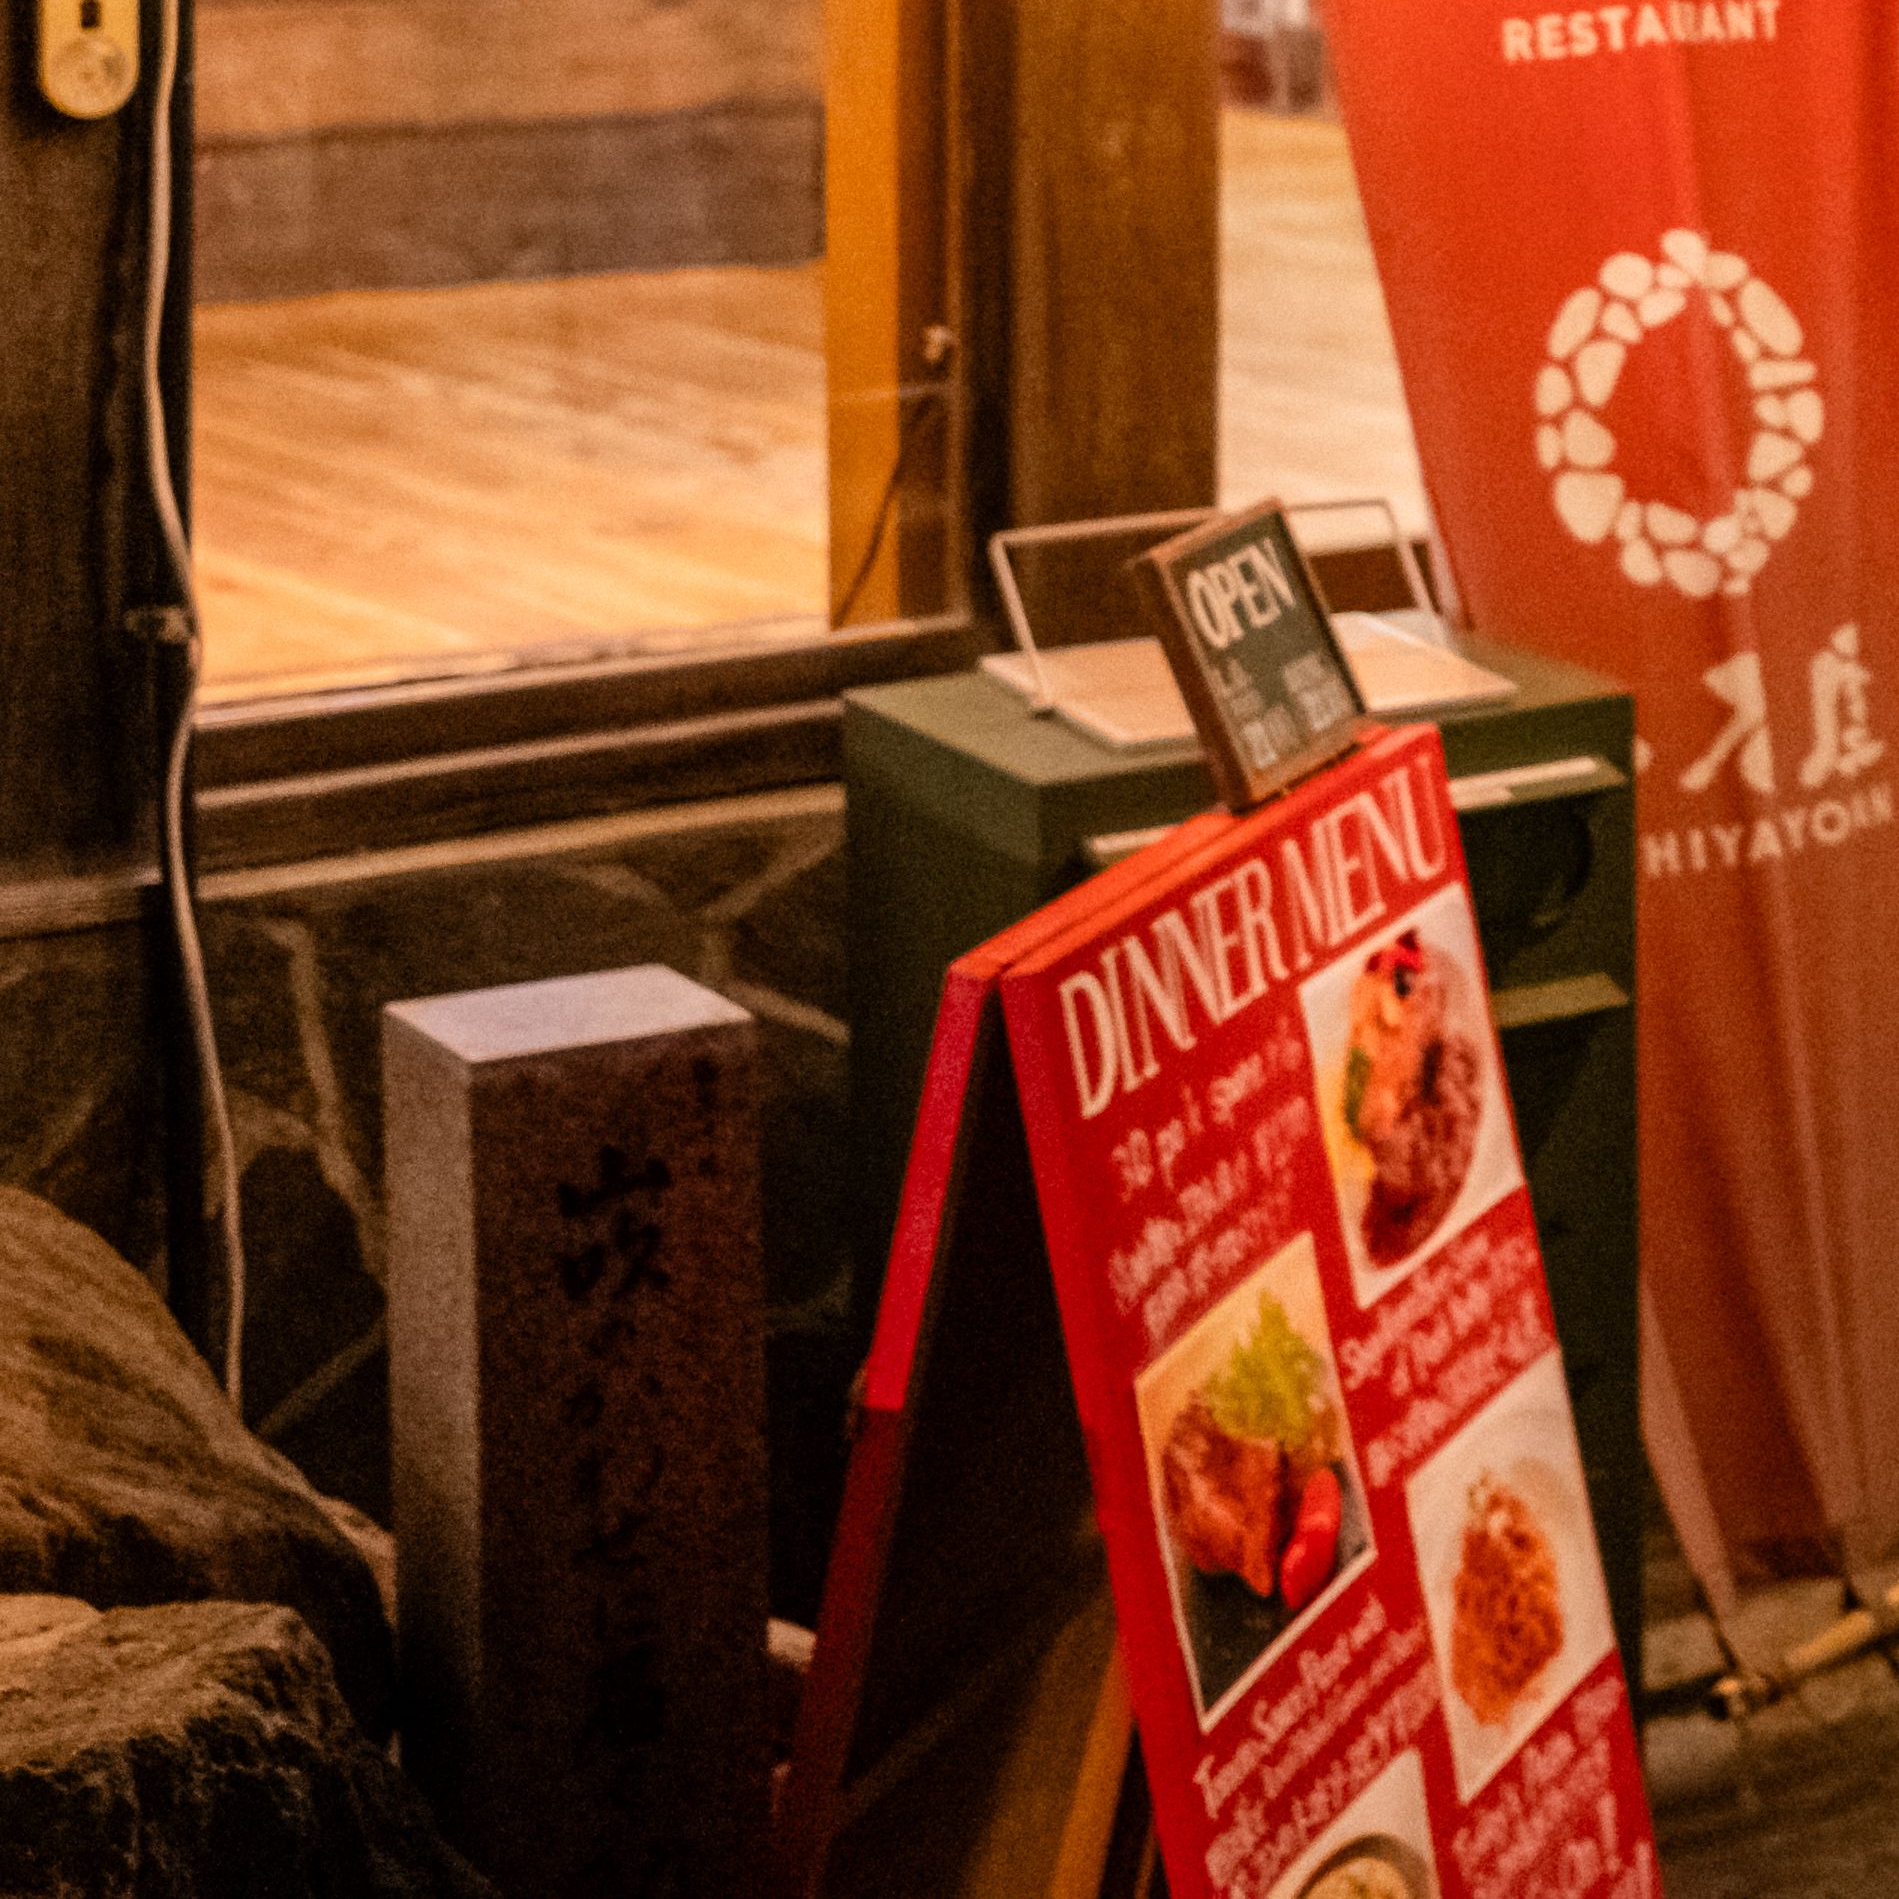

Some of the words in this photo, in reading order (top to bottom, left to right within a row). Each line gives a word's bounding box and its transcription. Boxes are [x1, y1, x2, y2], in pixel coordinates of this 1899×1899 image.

[1186, 536, 1296, 650] OPEN
[1057, 856, 1291, 1120] DINNER
[1280, 752, 1450, 972] MENU
